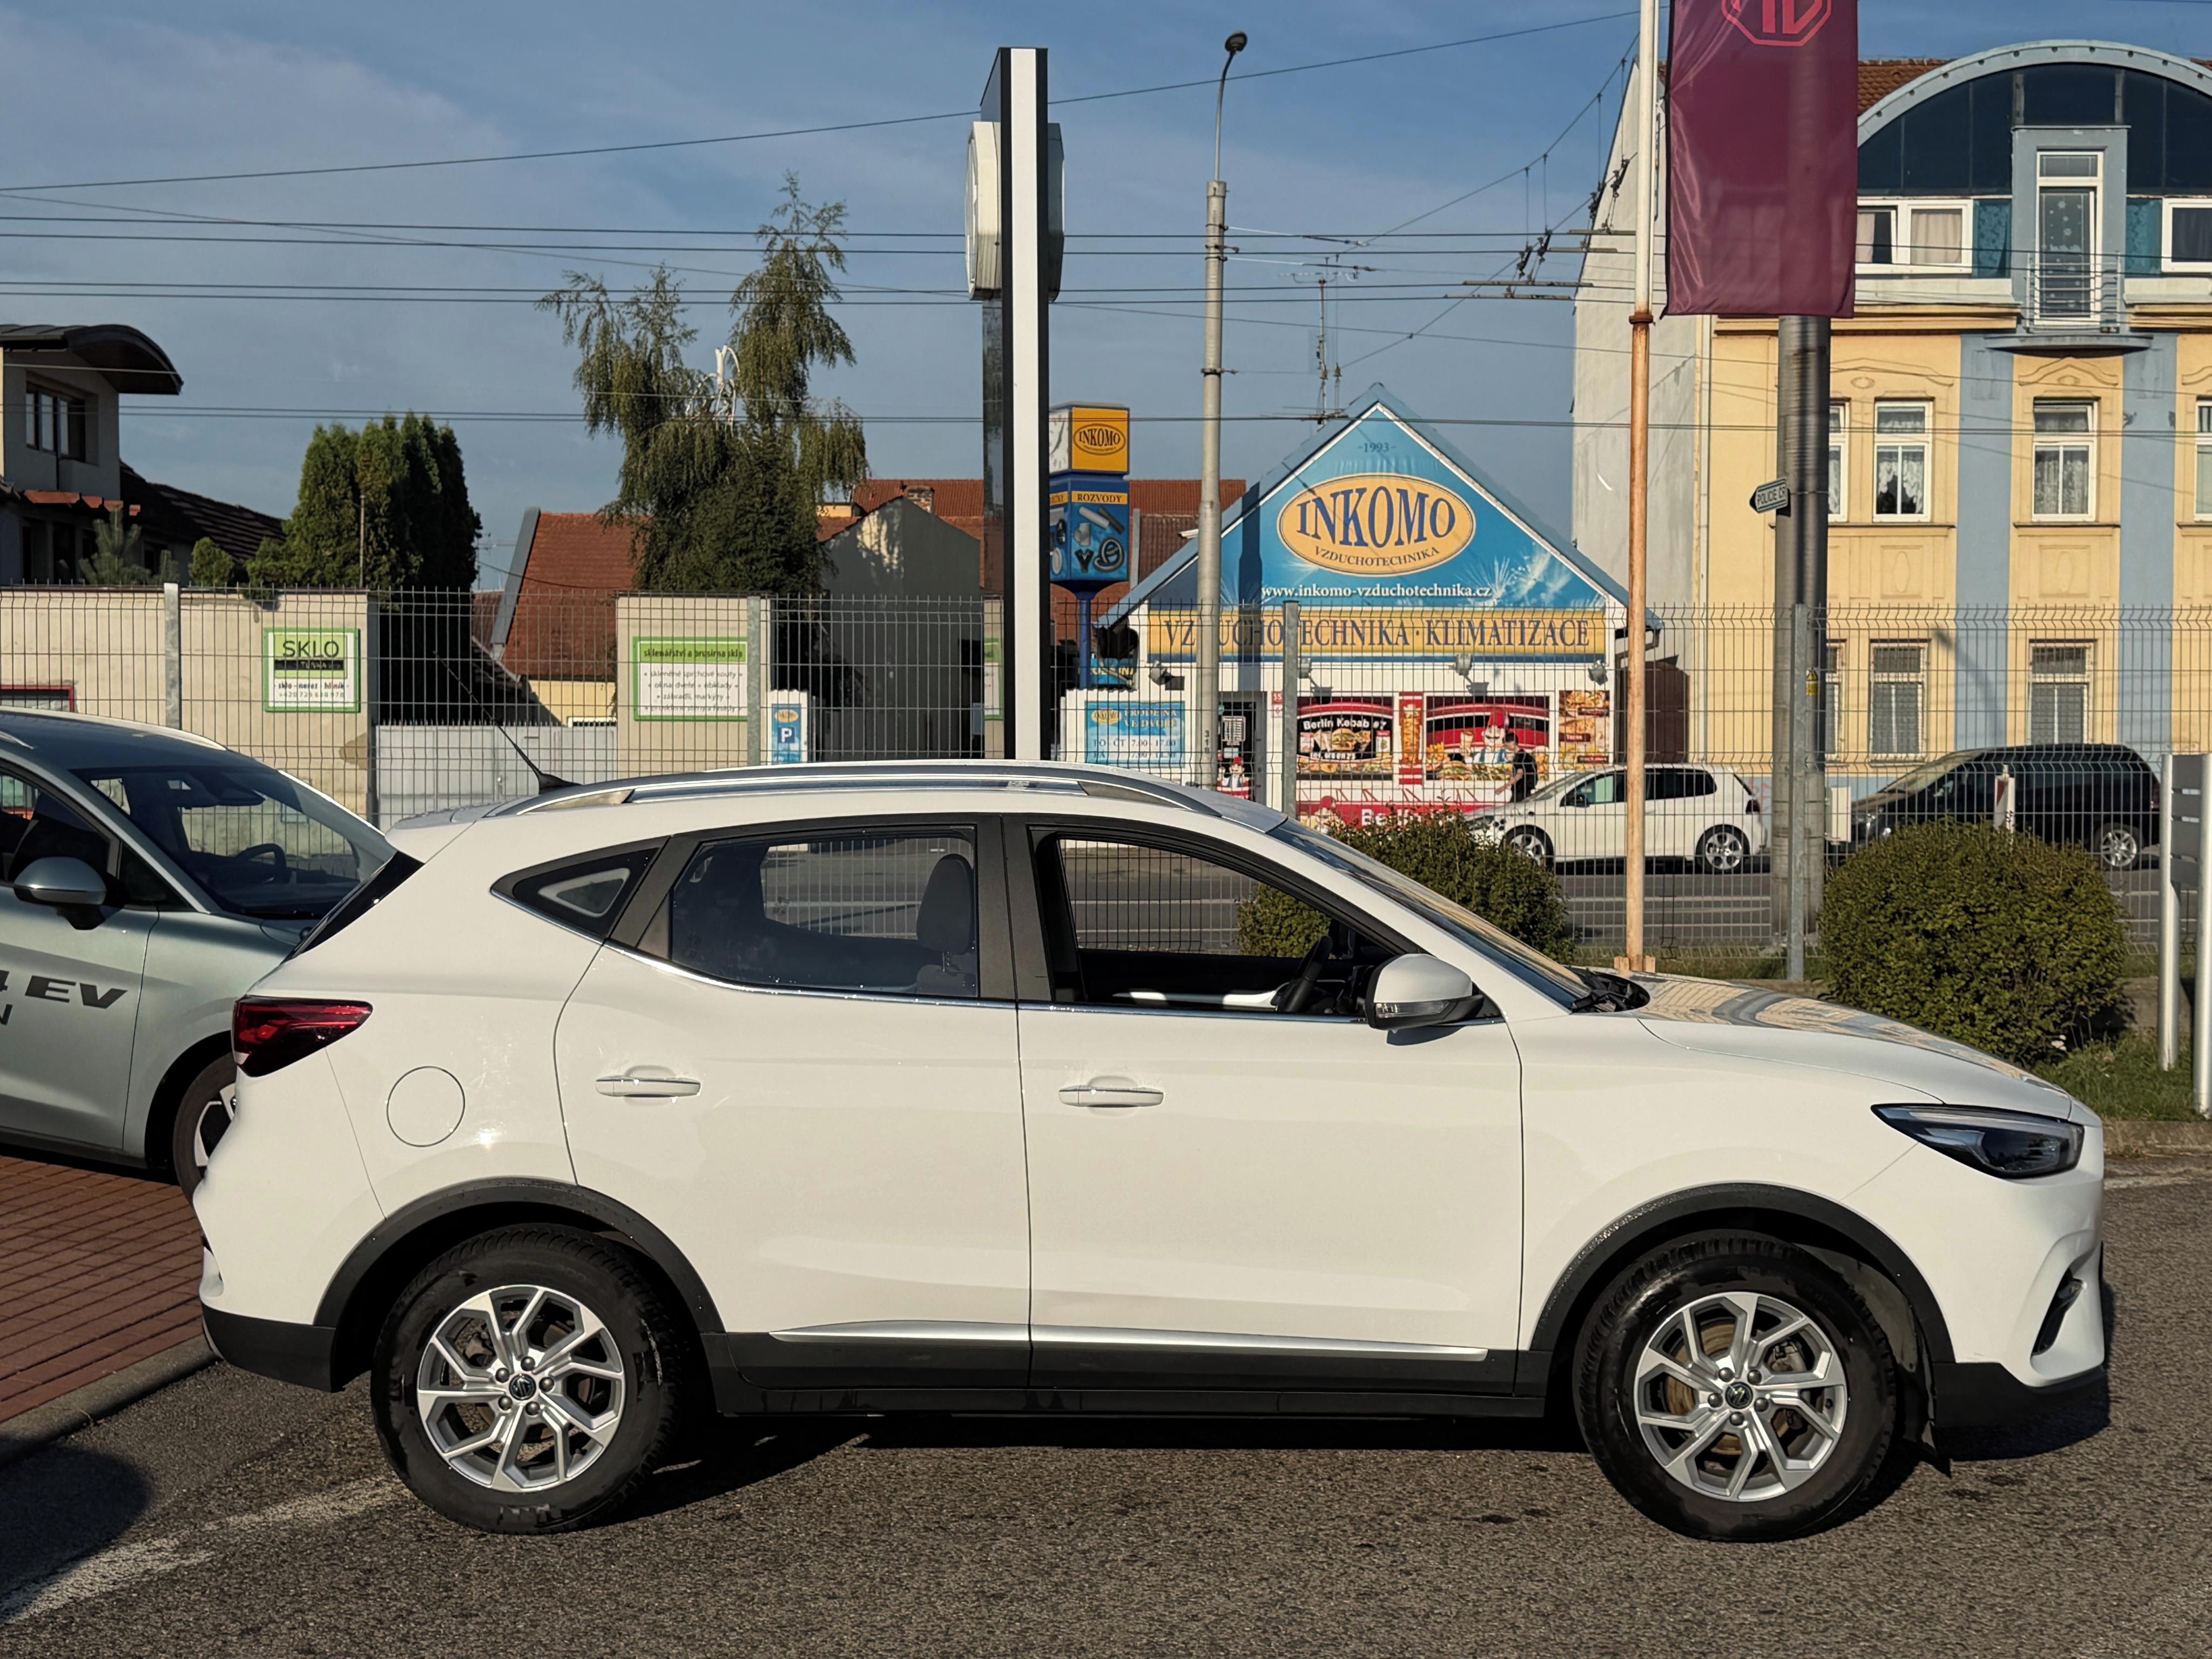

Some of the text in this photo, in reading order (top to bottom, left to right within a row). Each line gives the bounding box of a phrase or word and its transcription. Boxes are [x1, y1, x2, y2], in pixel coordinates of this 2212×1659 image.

[1079, 428, 1121, 447] INKOMO
[1077, 493, 1123, 503] ROZVODY
[1296, 485, 1457, 549] INKOMO
[1314, 545, 1440, 567] VZDUCHOTECHNIKA
[1261, 583, 1492, 598] www.inkomo-vzduchotechnika.cz
[1164, 619, 1590, 648] VZUCHOECHNIKA KLIMATIZACE
[282, 641, 339, 658] SKLO
[1303, 719, 1334, 730] Berlin
[1337, 718, 1370, 729] Kebab
[781, 727, 792, 743] P
[25, 975, 129, 1009] EV
